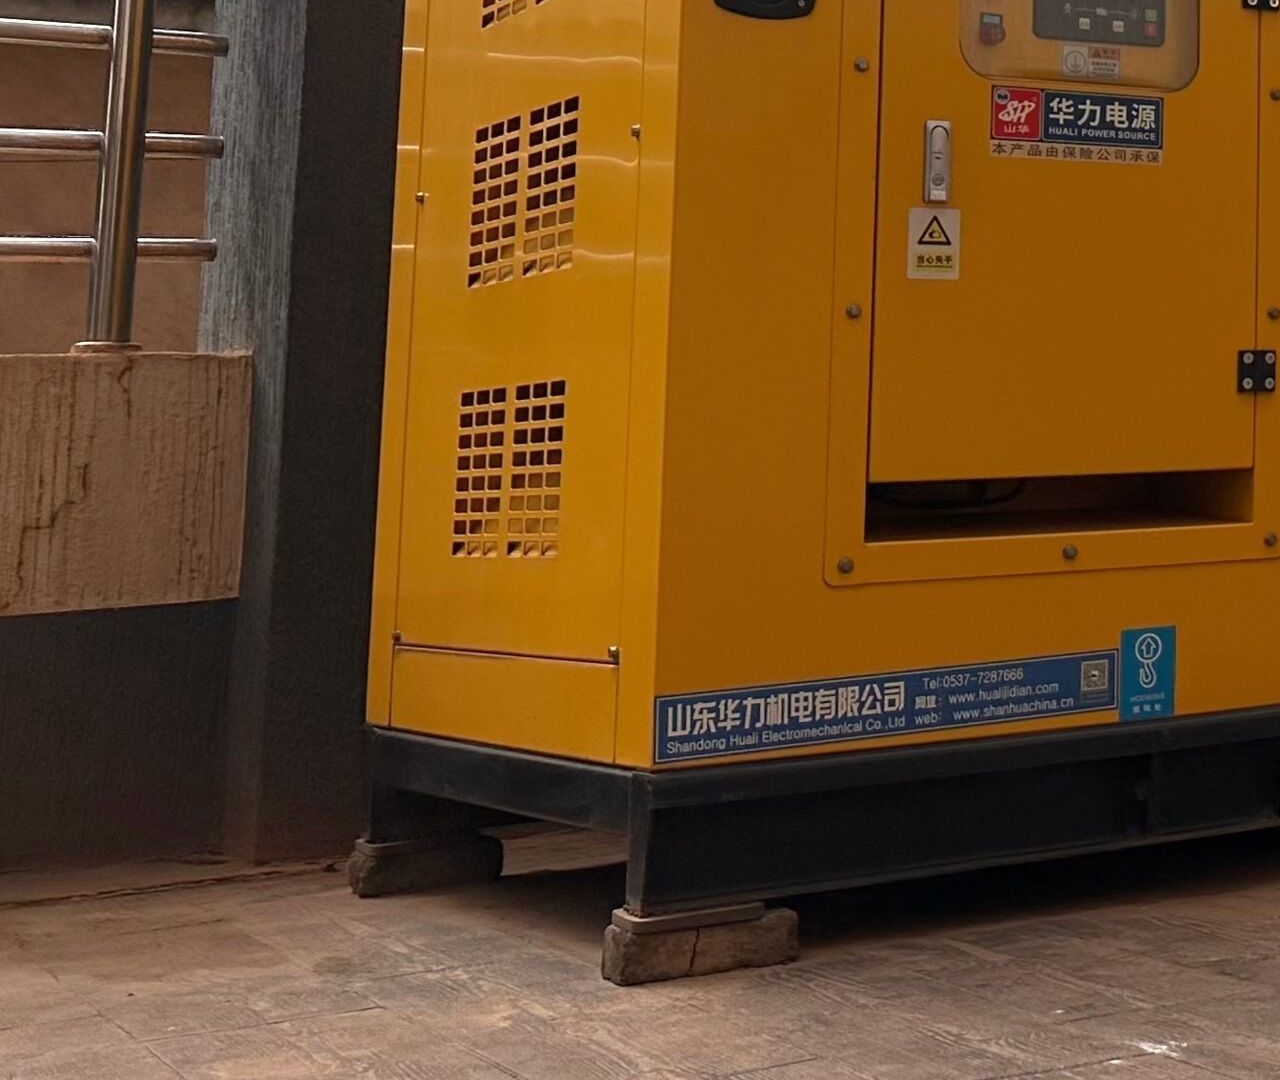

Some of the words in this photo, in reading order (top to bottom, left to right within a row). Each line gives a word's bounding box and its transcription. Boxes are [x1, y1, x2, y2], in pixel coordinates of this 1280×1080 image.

[1049, 98, 1156, 129] 华力电源
[1049, 126, 1078, 136] HUALI
[1082, 128, 1116, 139] POWER
[1118, 131, 1156, 141] SOURCE
[992, 143, 1160, 163] 本产品由保险公司承保
[948, 682, 1060, 705] www.hualijidian.com
[667, 681, 905, 737] 山东华力机电有限公司
[952, 697, 1074, 720] www.shanhuachina.cn
[667, 737, 726, 755] Shandong
[729, 731, 759, 747] Huali
[762, 720, 863, 743] Electromechanical
